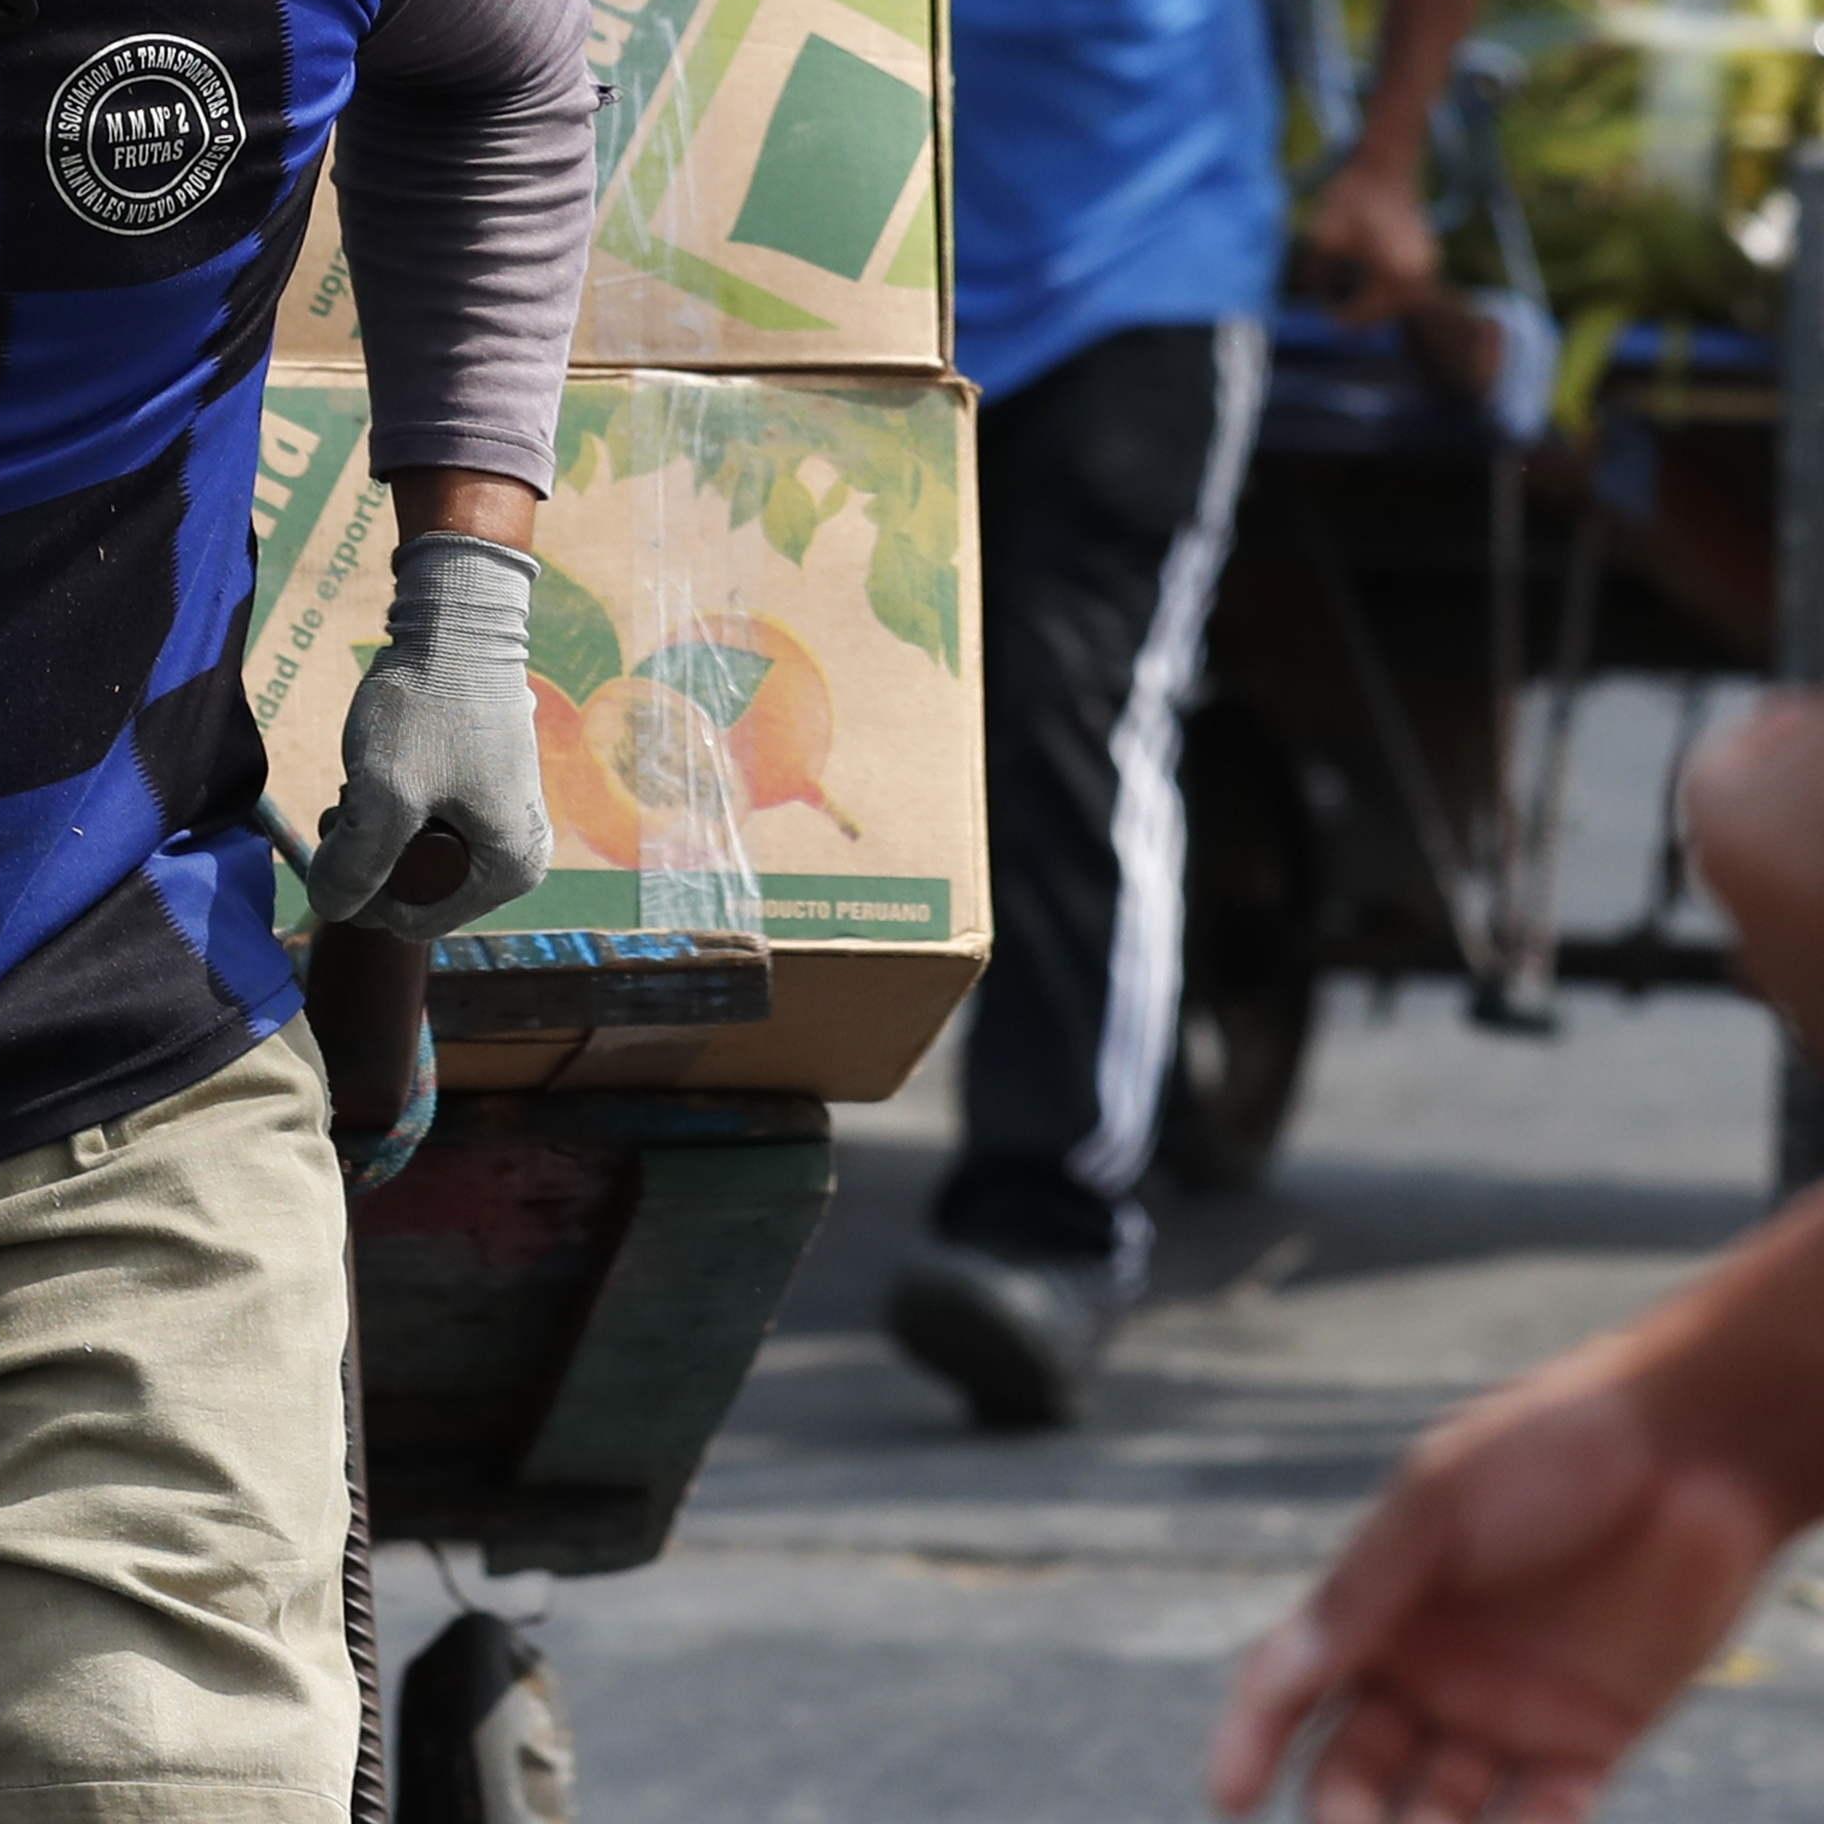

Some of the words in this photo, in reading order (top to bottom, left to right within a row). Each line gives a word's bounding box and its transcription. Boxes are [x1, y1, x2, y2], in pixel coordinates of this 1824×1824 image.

[57, 61, 114, 142] ASOCIACION
[113, 50, 135, 77] DE
[137, 45, 230, 120] TRANSPORTISTAS
[175, 101, 191, 135] 2
[113, 138, 186, 170] FRUTAS
[59, 152, 126, 222] MANUALES
[125, 196, 176, 224] NUEVO
[175, 134, 235, 208] PROGRESO
[289, 607, 324, 651] de
[835, 901, 931, 923] PERUANO
